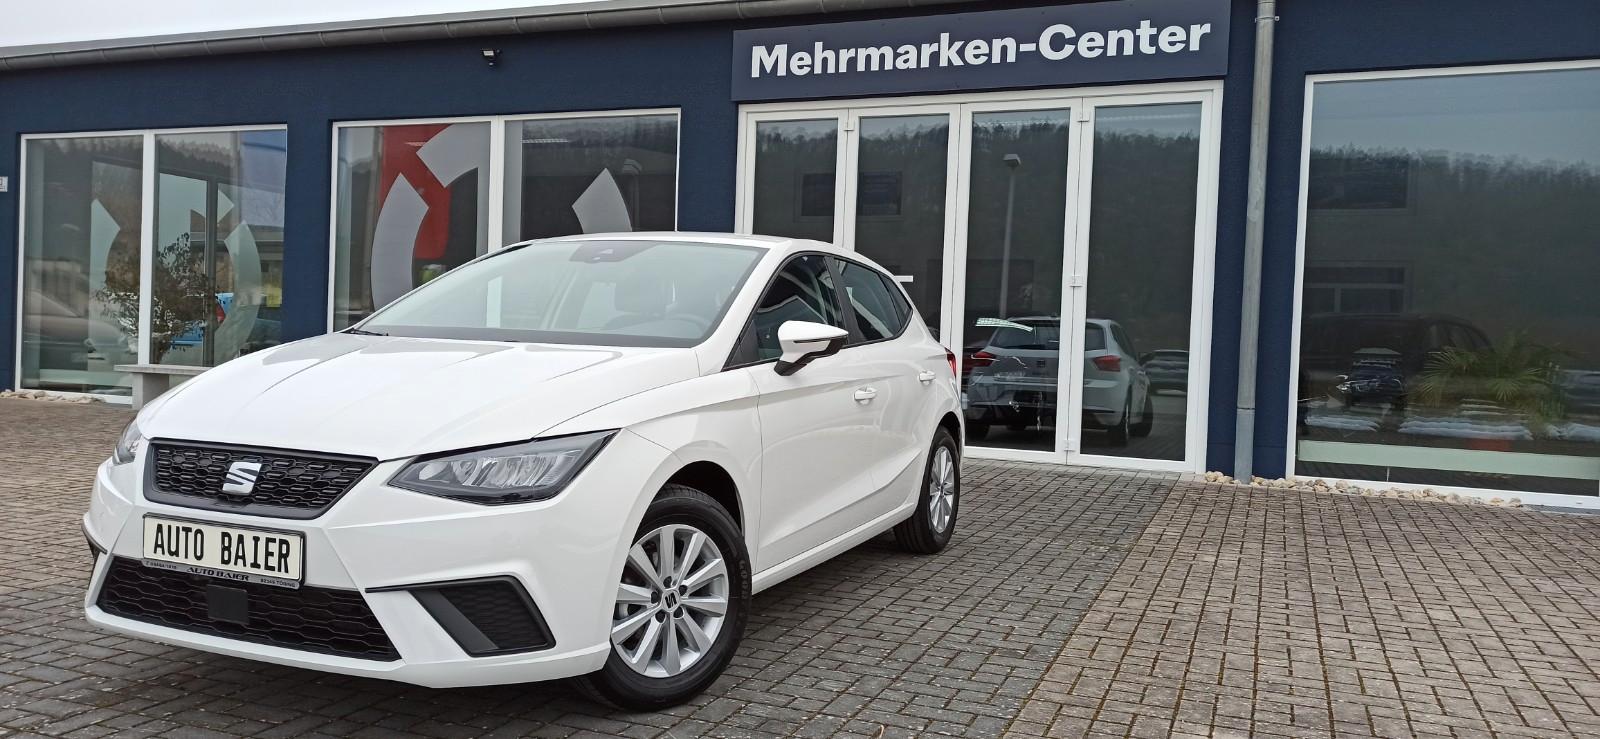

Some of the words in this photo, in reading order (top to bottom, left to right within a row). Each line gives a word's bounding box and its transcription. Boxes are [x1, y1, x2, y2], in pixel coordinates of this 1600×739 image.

[750, 19, 1211, 78] Mehrmarken-Center
[153, 523, 205, 561] AUTO
[220, 531, 291, 574] BAIER
[186, 566, 215, 576] AUTO
[216, 571, 250, 581] BAIER
